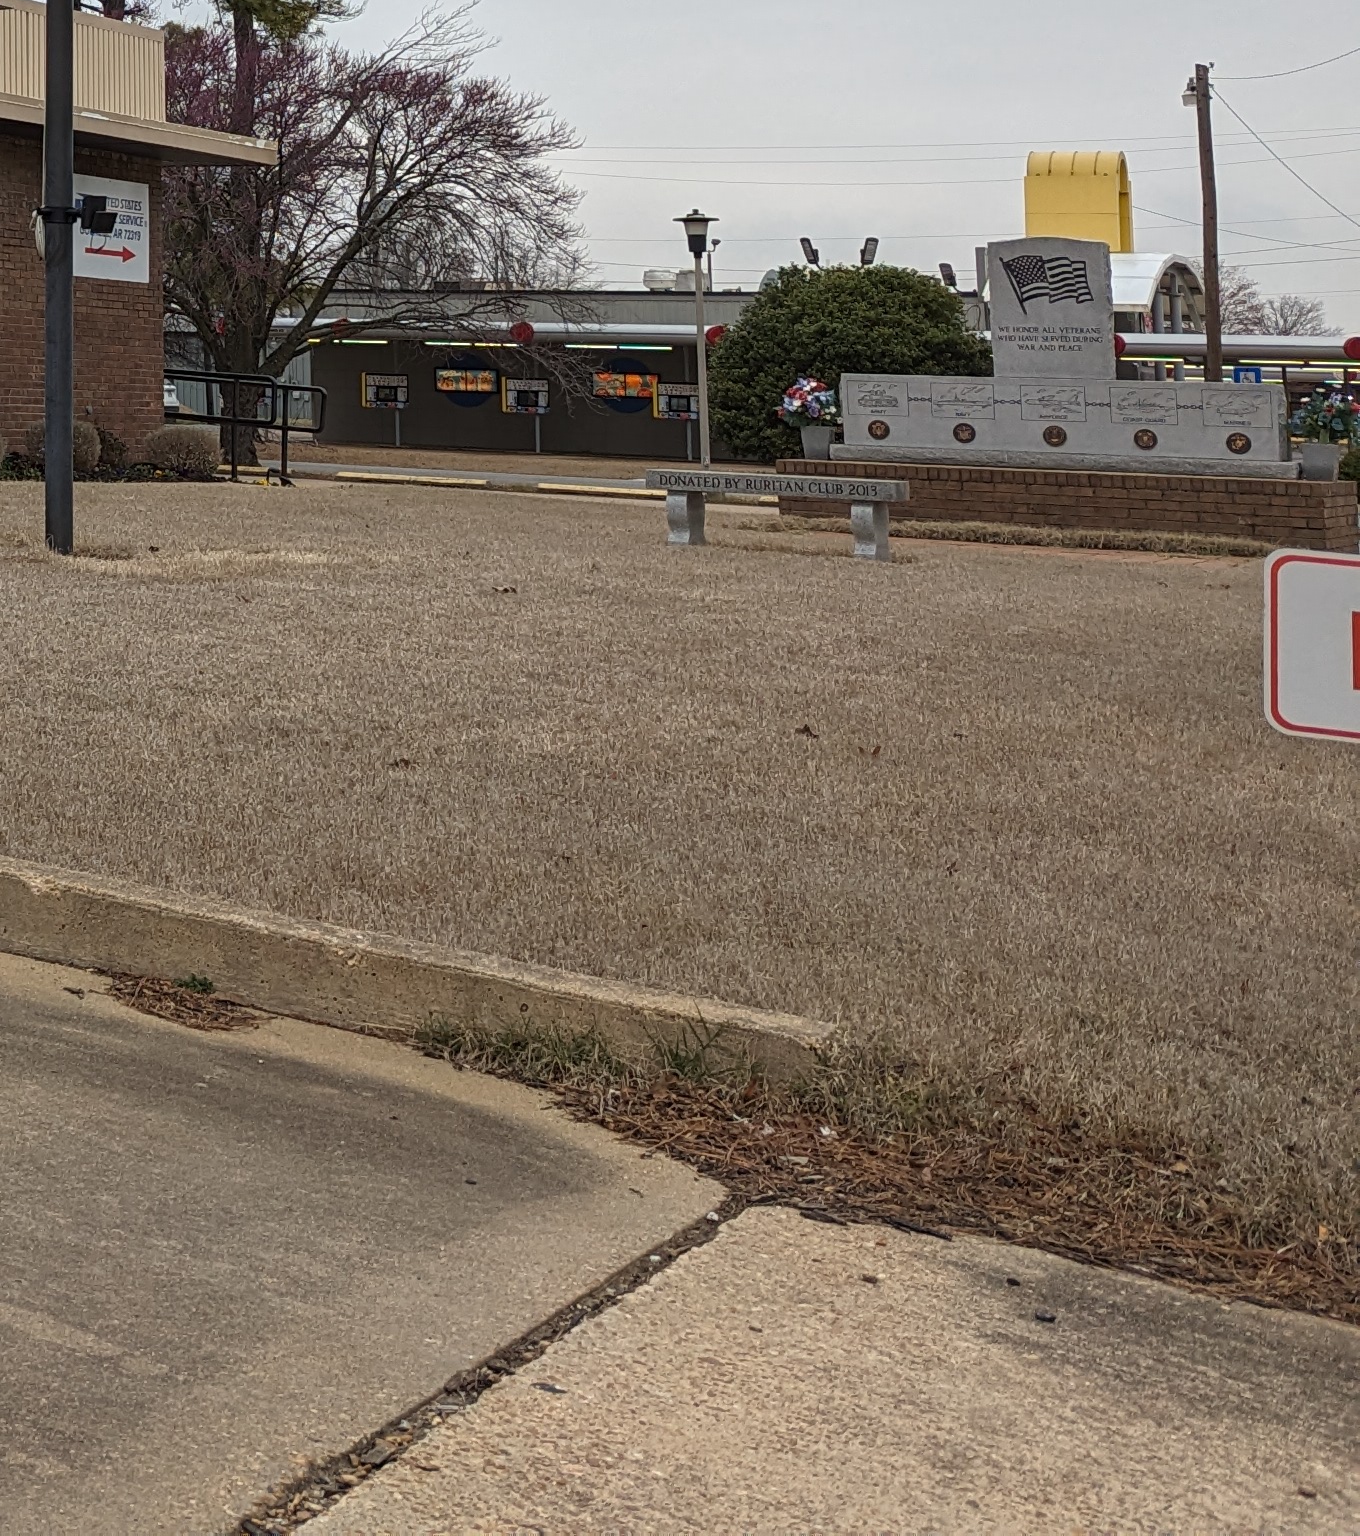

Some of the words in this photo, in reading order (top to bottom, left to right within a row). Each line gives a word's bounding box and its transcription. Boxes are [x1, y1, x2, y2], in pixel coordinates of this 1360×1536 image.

[120, 198, 143, 211] STATES
[118, 214, 144, 227] SERVICE
[113, 228, 123, 240] AR
[1042, 326, 1057, 334] ALL
[1059, 326, 1101, 334] VETERANS
[997, 334, 1016, 342] WHO
[1072, 336, 1103, 344] DURING
[1017, 343, 1036, 351] WAR
[1038, 344, 1056, 352] AND
[1058, 344, 1083, 352] PEACE
[659, 474, 721, 489] DONATED
[724, 477, 741, 490] BY
[745, 479, 805, 494] RURITAN
[808, 482, 844, 495] CLUB
[848, 483, 879, 497] 2013
